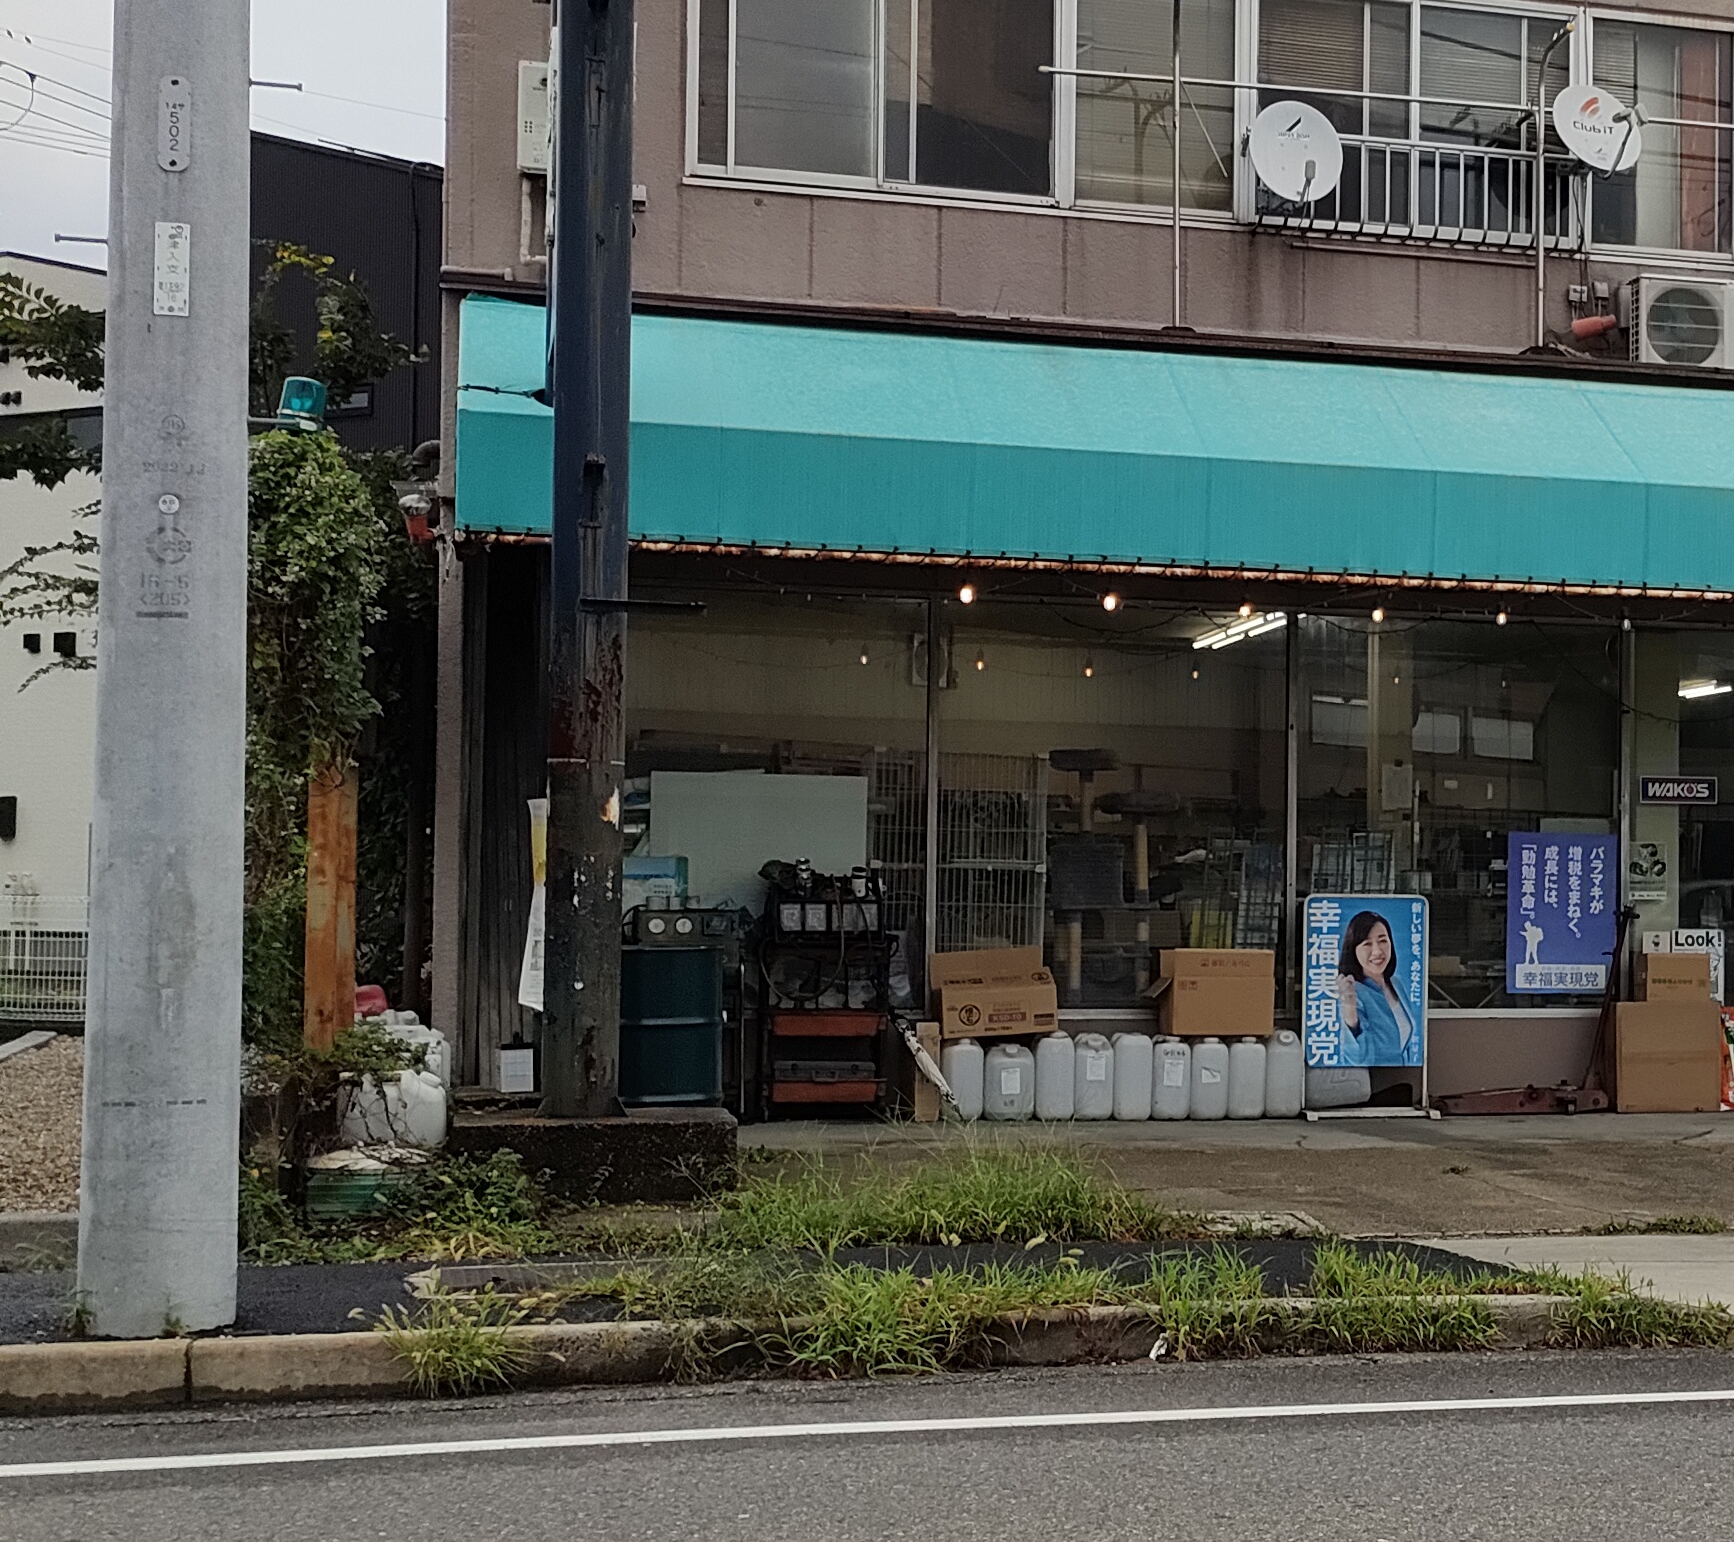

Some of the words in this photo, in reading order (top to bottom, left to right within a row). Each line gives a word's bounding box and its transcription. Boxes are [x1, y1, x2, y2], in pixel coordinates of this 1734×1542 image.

[169, 111, 180, 152] 502
[1573, 120, 1602, 134] Club
[1589, 846, 1605, 915] バラマキが
[1674, 930, 1722, 948] Look!
[1307, 899, 1342, 1066] 幸福実現党
[1522, 971, 1599, 988] 幸福実現党
